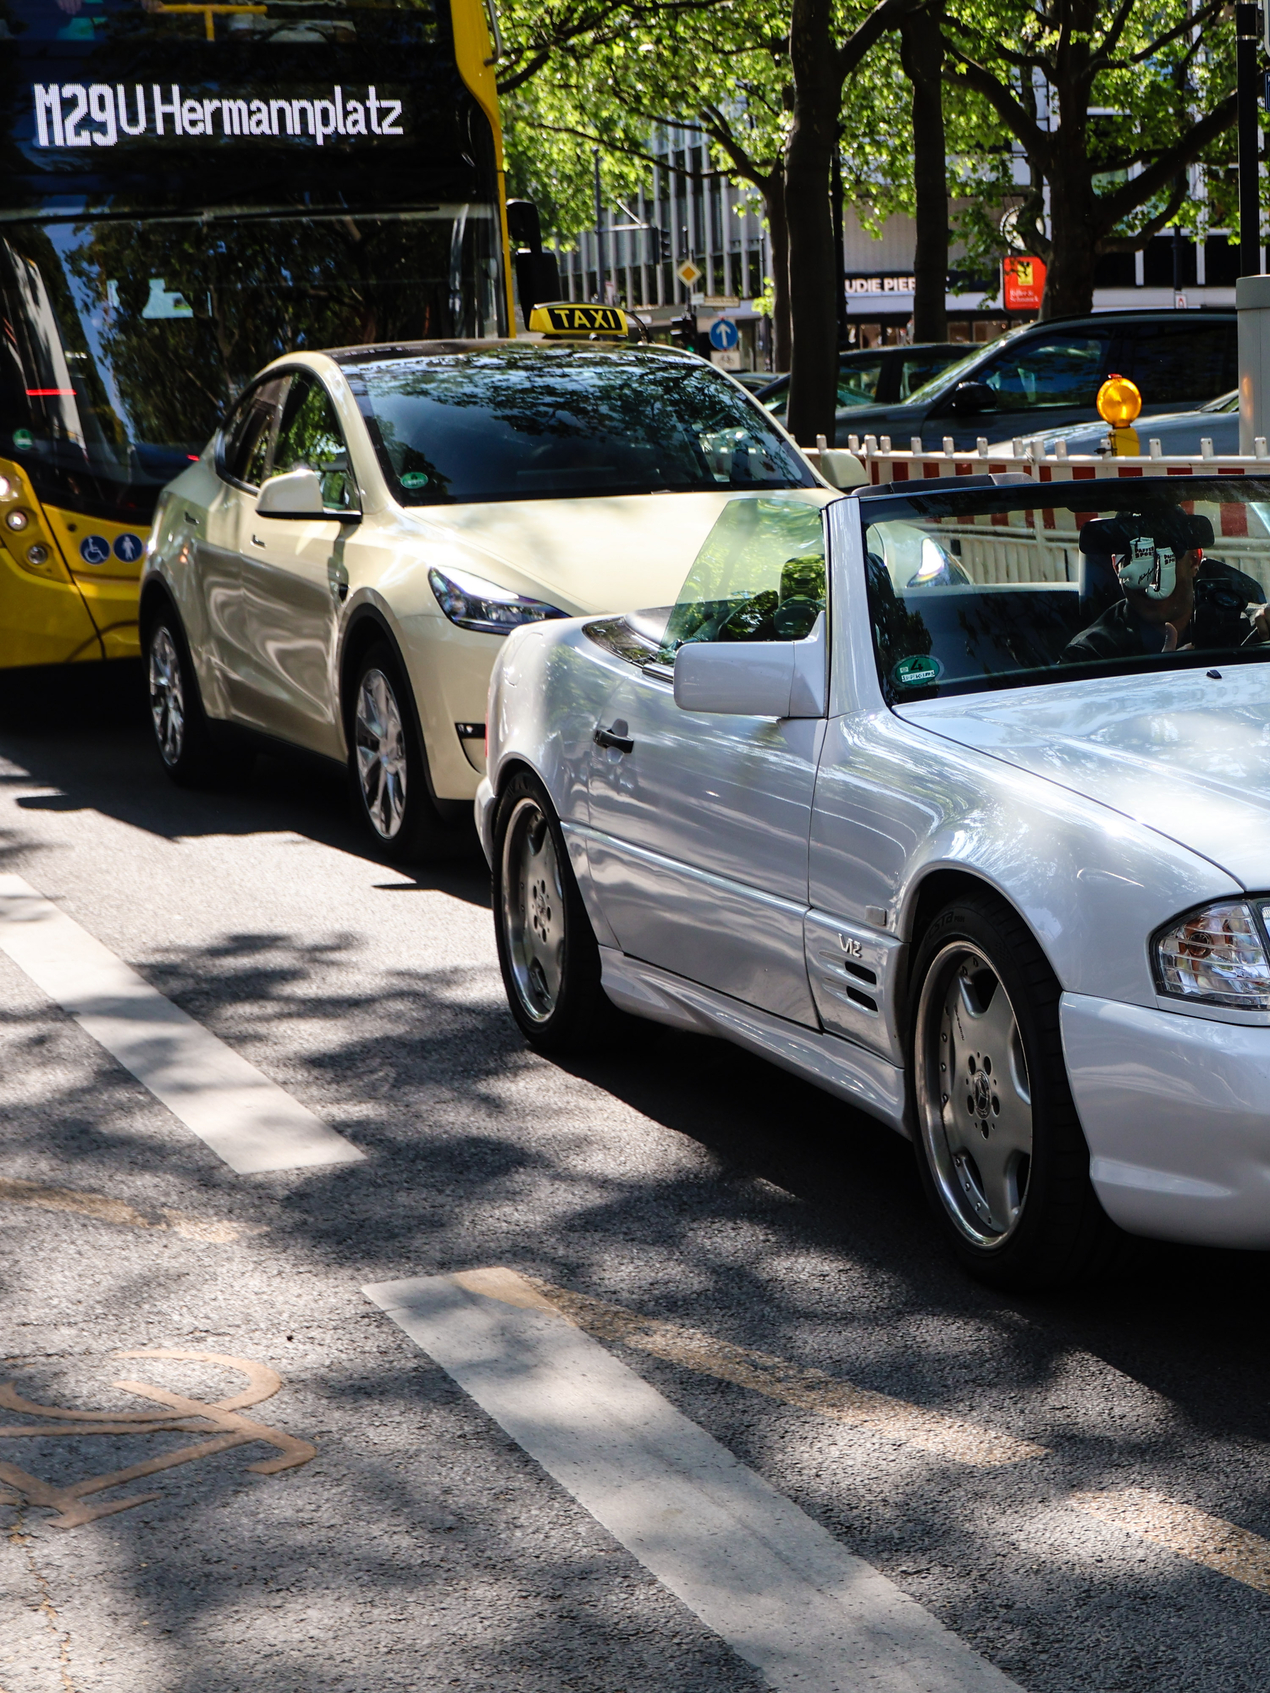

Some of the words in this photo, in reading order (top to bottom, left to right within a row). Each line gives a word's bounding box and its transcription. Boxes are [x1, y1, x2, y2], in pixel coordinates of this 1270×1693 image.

[33, 83, 118, 147] M29
[116, 83, 147, 136] U
[152, 84, 404, 146] Hermannplatz
[553, 308, 616, 329] TAXI
[838, 933, 862, 957] V12
